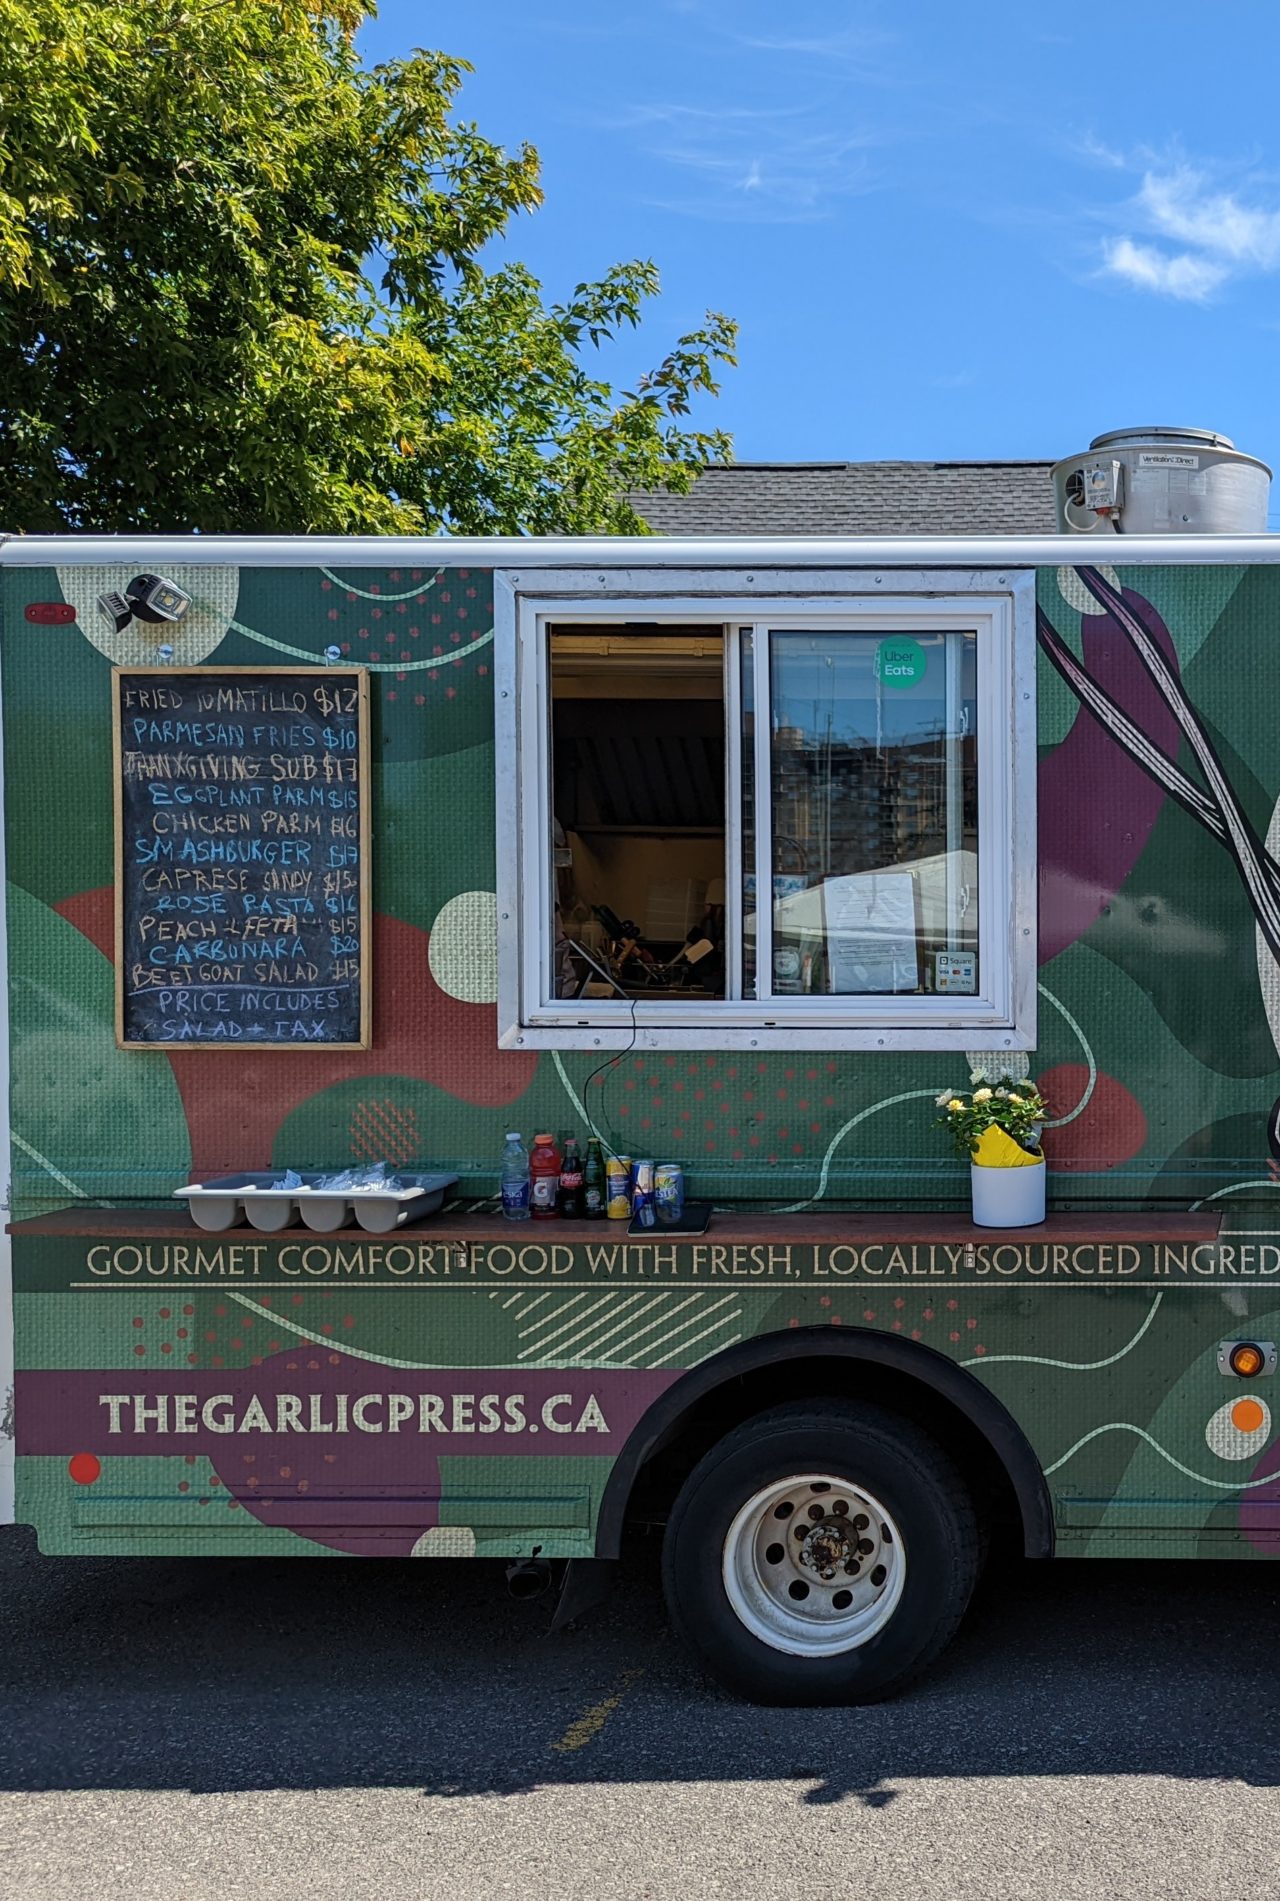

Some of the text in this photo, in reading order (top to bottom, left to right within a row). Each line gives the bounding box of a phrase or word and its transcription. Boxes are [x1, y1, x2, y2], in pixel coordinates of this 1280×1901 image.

[884, 651, 914, 662] Uber
[884, 664, 915, 676] Eats
[124, 688, 184, 711] FRIED
[313, 684, 359, 717] $12
[133, 718, 357, 750] PARMESAN FRIES $10
[269, 753, 318, 783] SUB
[148, 782, 357, 809] EGGPLANT PARM $15
[152, 810, 357, 838] CHICKEN PARM $16
[135, 836, 312, 865] SMASHBURGER
[142, 868, 249, 892] CAPRESE
[242, 894, 315, 916] PASTA
[139, 916, 217, 943] PEACH
[240, 914, 298, 940] FETA
[328, 916, 357, 934] $15
[149, 935, 359, 965] CARBONARA $20
[132, 963, 194, 990] BEET
[199, 964, 245, 983] GOAT
[254, 961, 318, 983] SALAD
[158, 991, 340, 1014] PRICE INCLUDES
[159, 1020, 242, 1040] SALAD
[275, 1020, 327, 1040] TAX
[86, 1245, 269, 1276] GOURMET
[277, 1245, 456, 1276] COMFORT
[469, 1245, 574, 1276] FOOD
[584, 1245, 678, 1276] WITH
[691, 1245, 801, 1279] FRESH,
[812, 1245, 963, 1276] LOCALLY
[975, 1244, 1141, 1276] SOURCED
[98, 1393, 611, 1435] THEGARLICPRESS.CA
